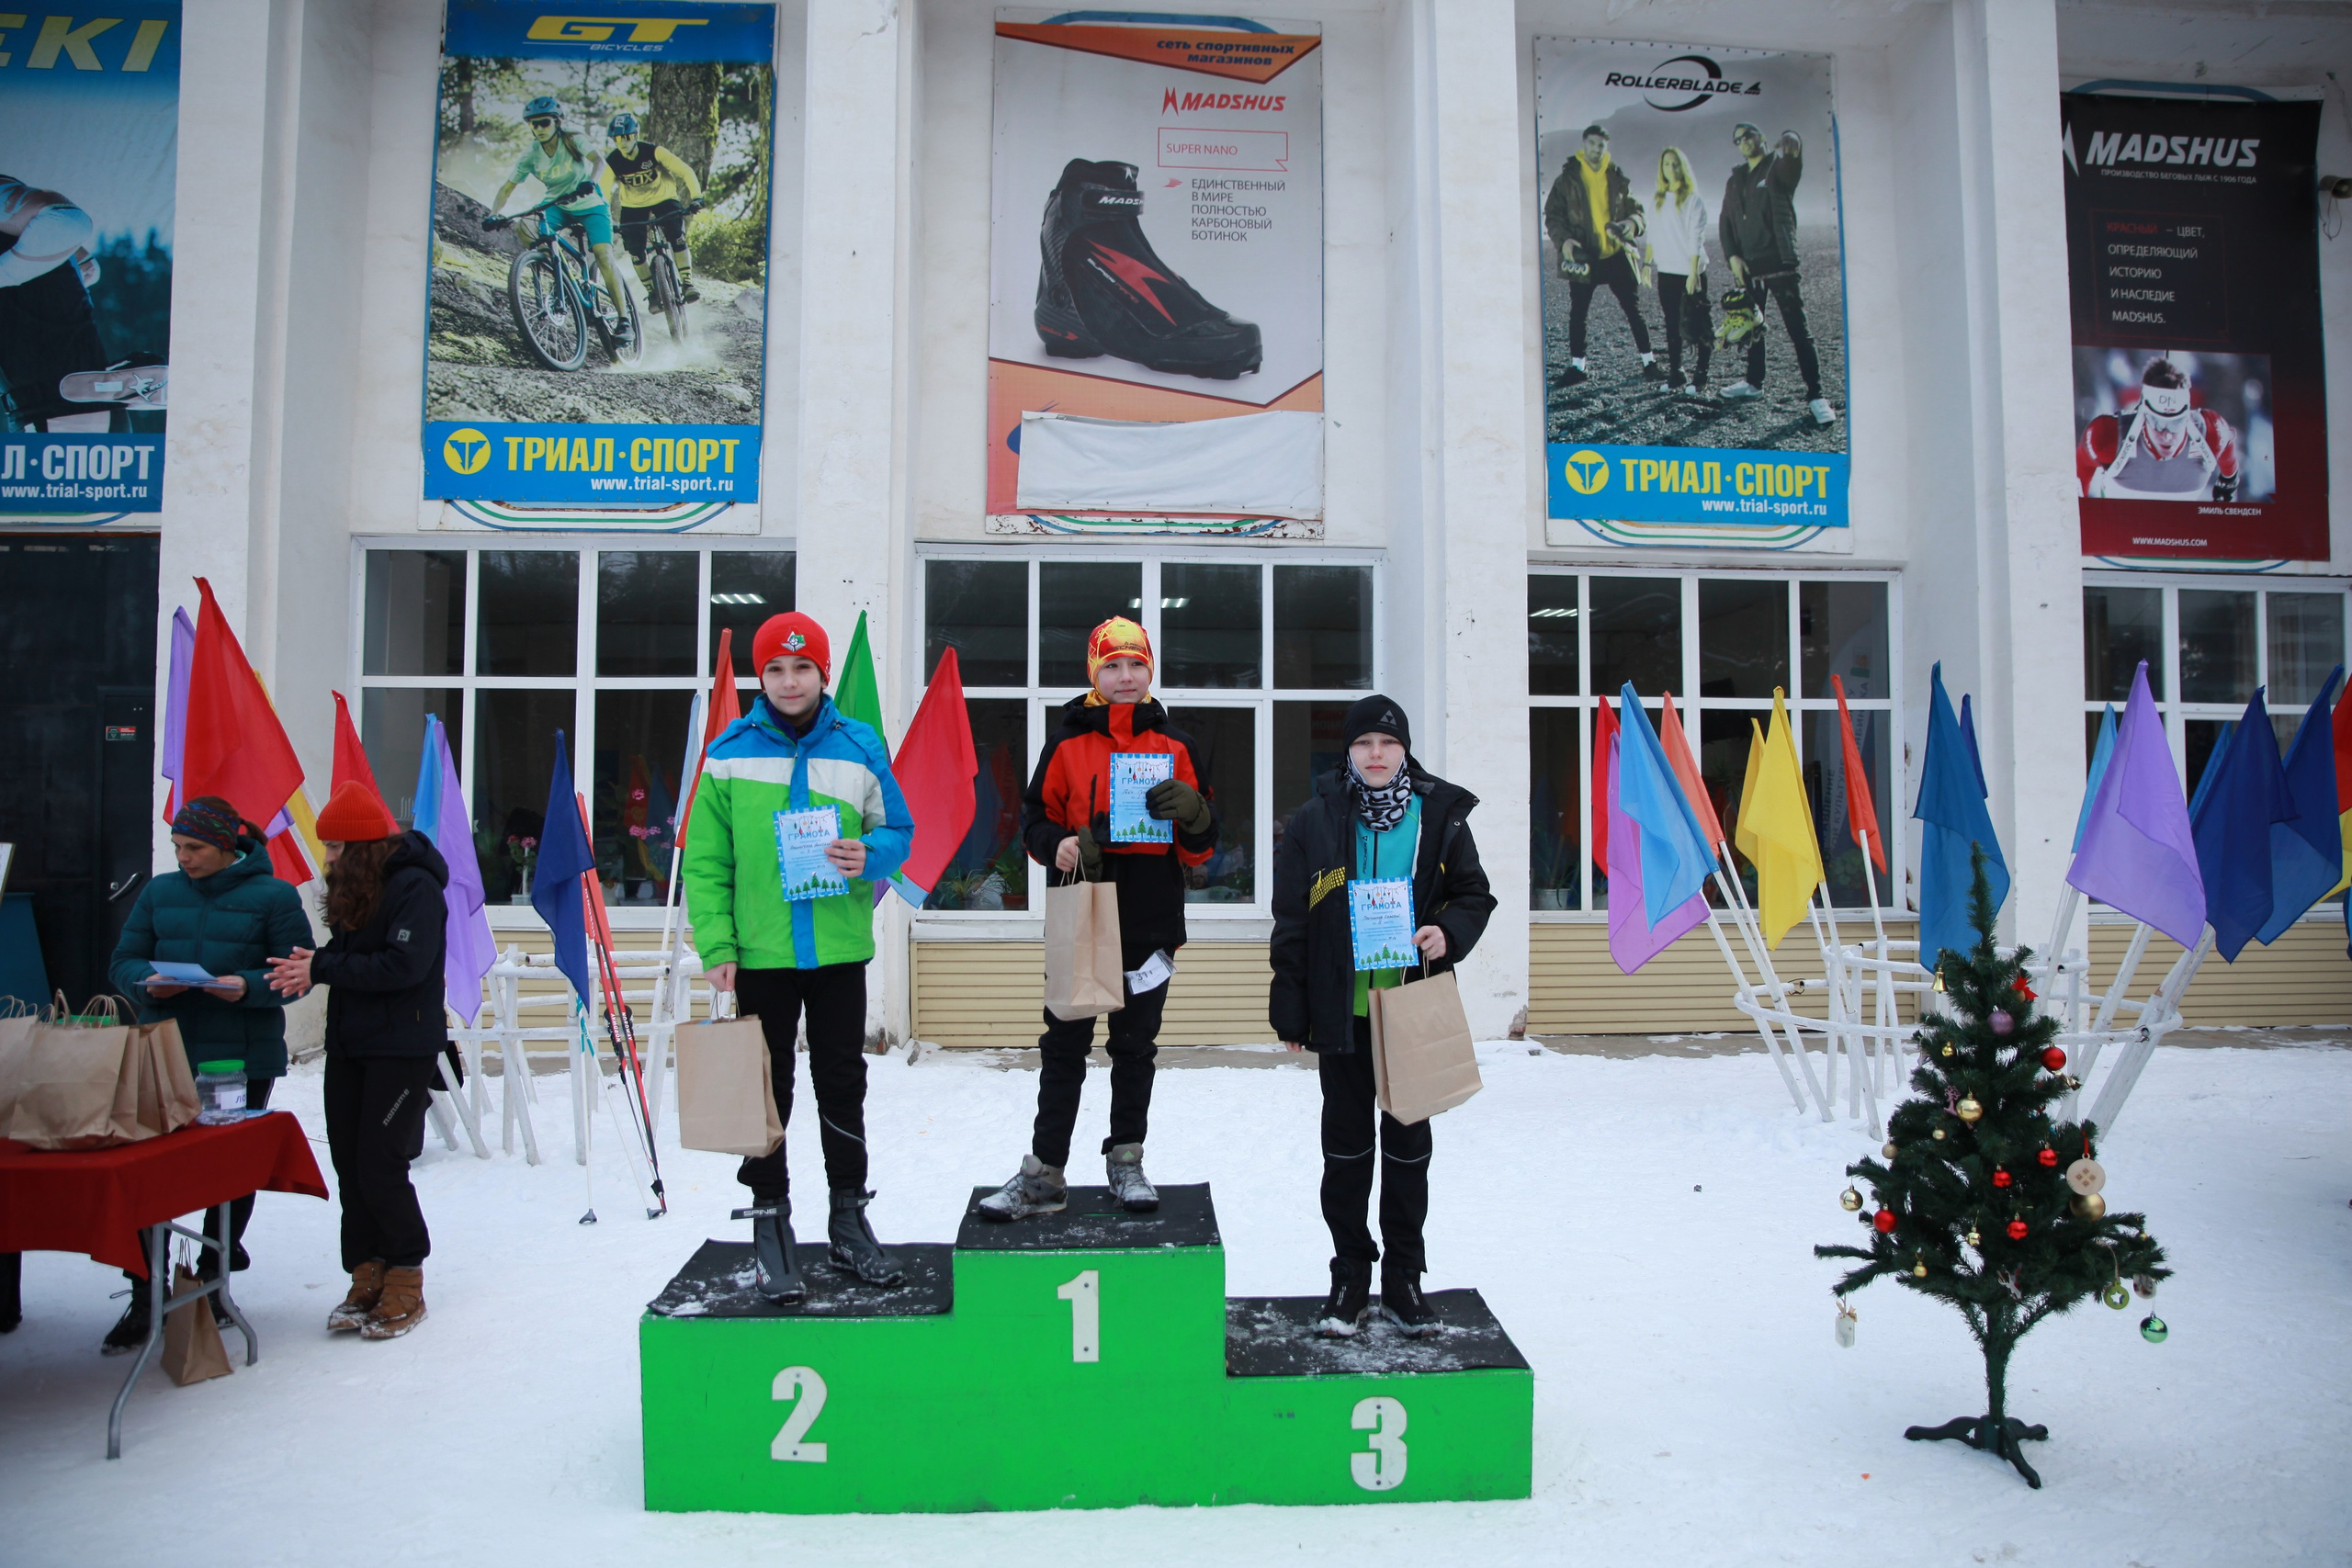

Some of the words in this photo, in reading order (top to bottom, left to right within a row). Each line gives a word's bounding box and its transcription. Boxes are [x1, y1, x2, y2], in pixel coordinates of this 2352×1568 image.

[526, 16, 709, 43] GT
[590, 43, 664, 52] BICYCLES
[1157, 39, 1192, 50] сеть
[1195, 41, 1295, 54] спортивных
[1187, 53, 1272, 65] магазинов
[1605, 72, 1744, 94] ROLLERBLADE
[1181, 92, 1286, 111] MADSHUS
[1166, 143, 1202, 154] SUPER
[1204, 145, 1238, 155] NANO
[2085, 130, 2260, 167] MADSHUS
[539, 161, 573, 180] FOX
[2100, 169, 2159, 180] ПРОИЗВОДСТВО
[2160, 172, 2193, 181] БЕГОВЫХ
[2194, 174, 2212, 182] ЛЫЖ
[2221, 175, 2237, 183] 1906
[2237, 175, 2256, 185] ГОДА
[624, 171, 653, 186] FOX
[1192, 178, 1285, 191] ЕДИНСТВЕННЫЙ
[1192, 192, 1199, 202] В
[1202, 192, 1234, 203] МИРЕ
[1192, 204, 1267, 217] ПОЛНОСТЬЮ
[1192, 218, 1272, 230] КАРБОНОВЫЙ
[2107, 222, 2158, 234] КРАСНЫЙ
[2177, 225, 2206, 239] ЦВЕТ,
[1192, 231, 1248, 242] БОТИНОК
[2108, 243, 2199, 260] ОПРЕДЕЛЯЮЩИЙ
[2109, 266, 2162, 279] ИСТОРИЮ
[2110, 288, 2119, 299] И
[2120, 288, 2176, 303] НАСЛЕДИЕ
[2111, 310, 2166, 324] MADSHUS.
[591, 475, 734, 494] www.trial-sport.ru
[1, 483, 148, 502] www.trial-sport.ru
[1702, 498, 1827, 516] www.trial-sport.ru
[2198, 506, 2223, 515] ЭМИЛЬ
[2224, 507, 2262, 516] СВЕНДСЕН
[2132, 536, 2208, 547] WWW.MADSHUS.COM
[1122, 777, 1161, 785] ГРАМОТА
[787, 829, 831, 840] ГРАМОТА
[1361, 901, 1402, 911] ГРАМОТА
[610, 1013, 621, 1043] NORDWAY
[383, 1089, 410, 1126] noname
[743, 1207, 777, 1217] SPINE
[1057, 1269, 1100, 1362] 1
[770, 1365, 828, 1462] 2
[1350, 1395, 1408, 1490] 3
